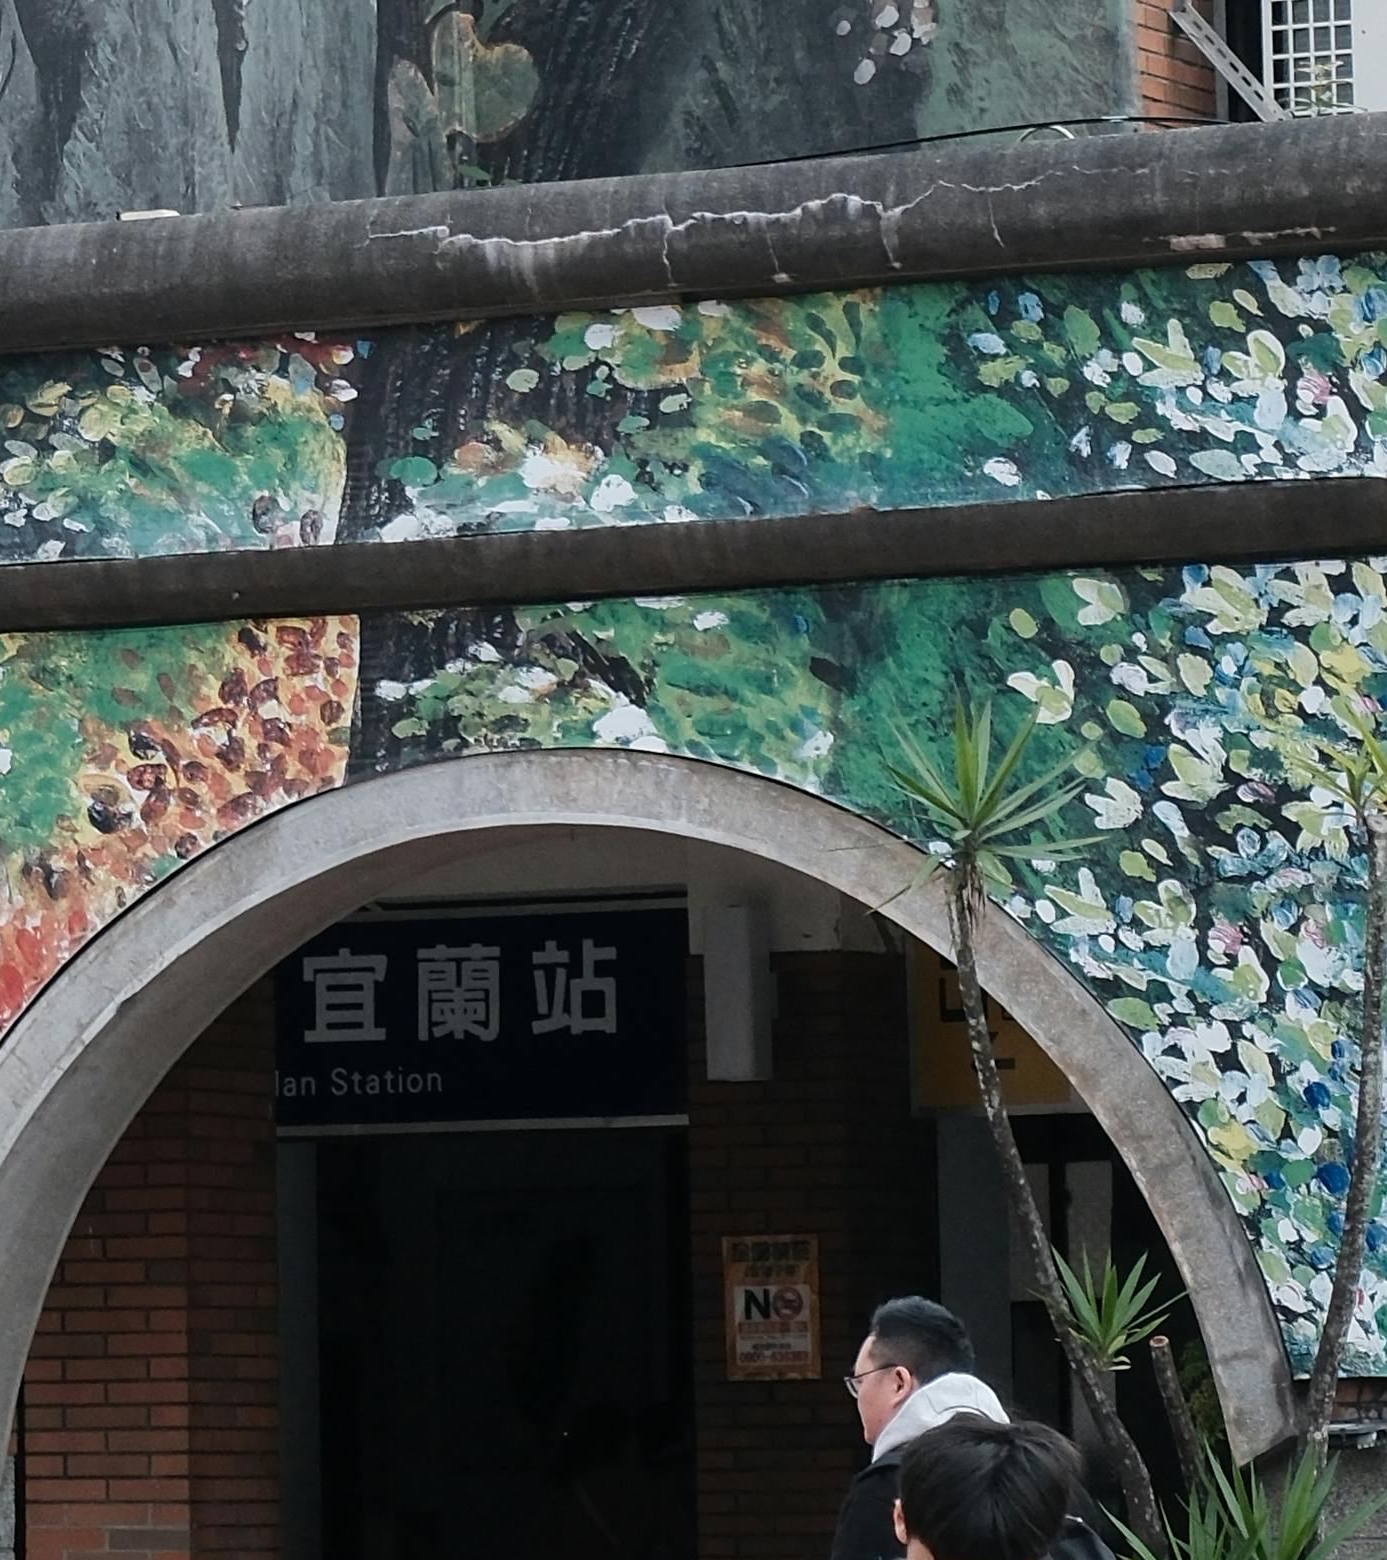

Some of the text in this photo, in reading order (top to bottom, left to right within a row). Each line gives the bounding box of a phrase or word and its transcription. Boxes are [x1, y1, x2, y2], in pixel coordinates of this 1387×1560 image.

[302, 938, 618, 1043] 宜蘭站
[274, 1064, 444, 1097] lan Station
